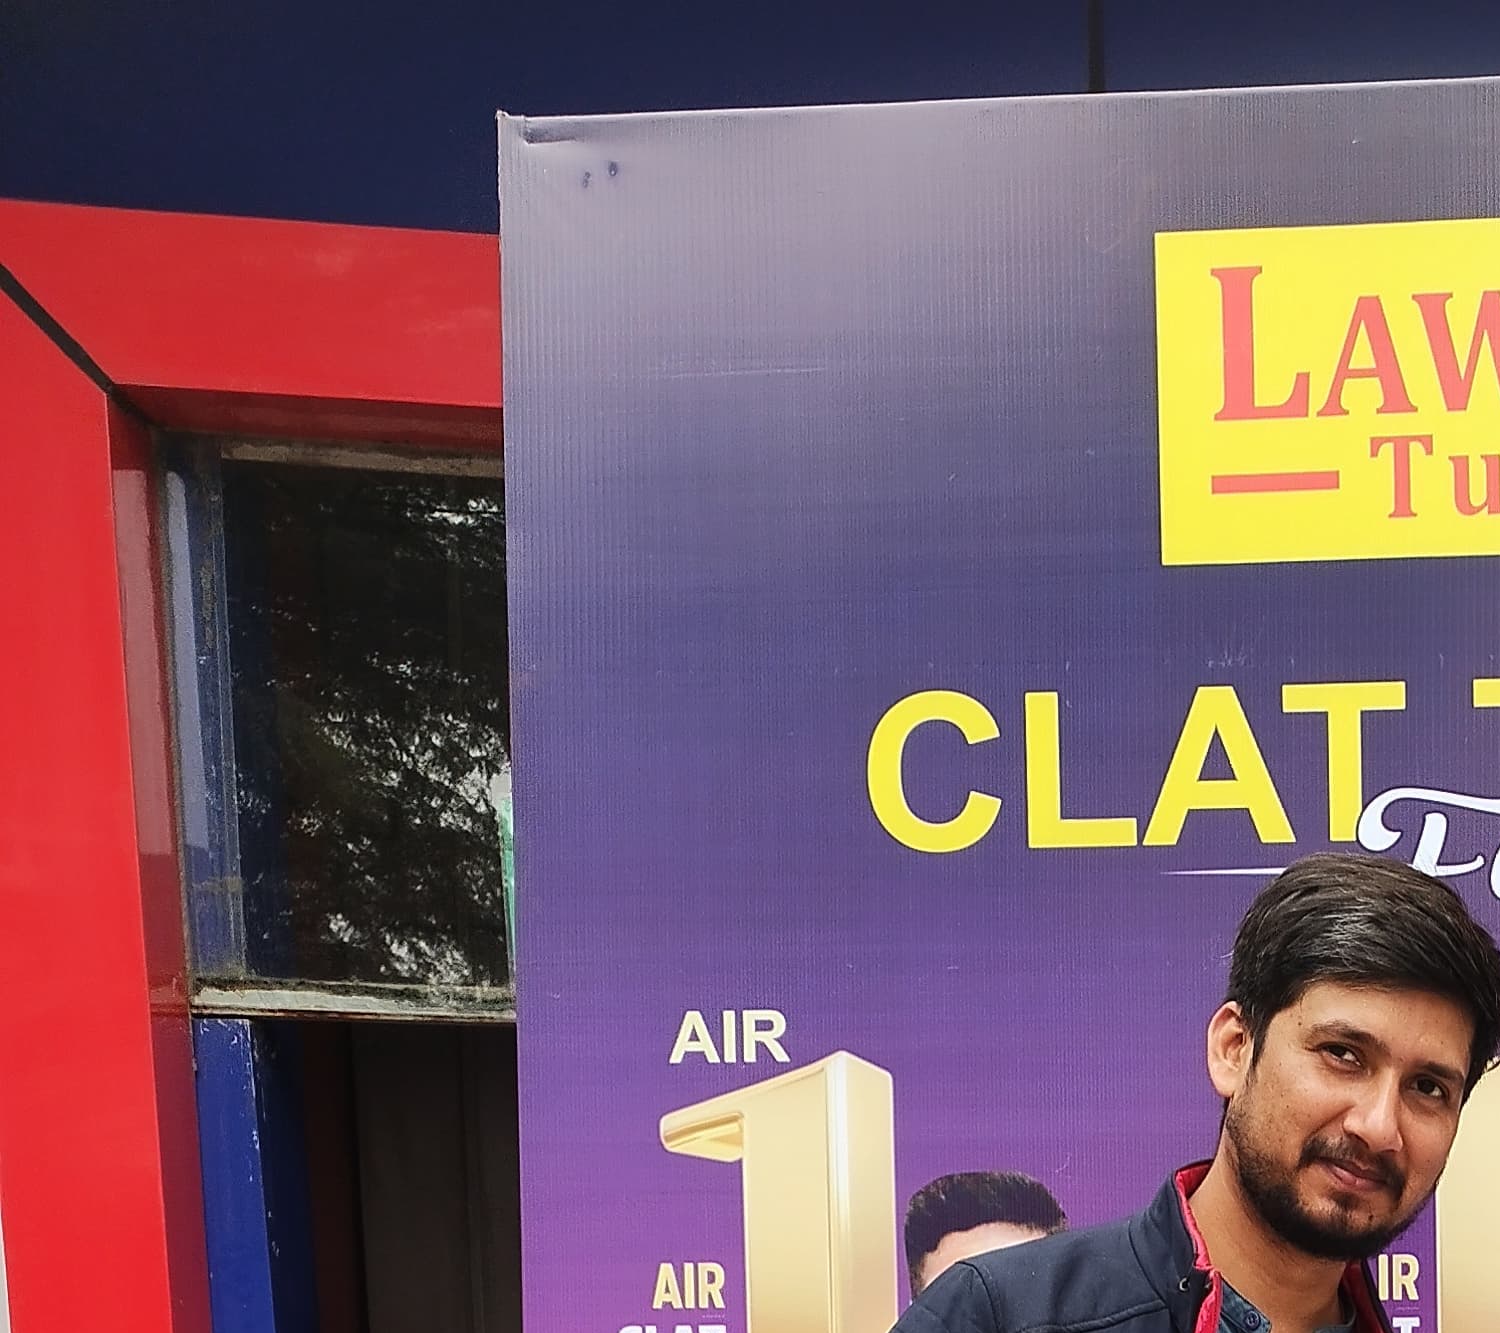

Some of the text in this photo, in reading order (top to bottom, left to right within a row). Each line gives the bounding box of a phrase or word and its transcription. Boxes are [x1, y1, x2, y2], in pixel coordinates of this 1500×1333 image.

[866, 680, 1407, 853] CLAT
[668, 1009, 791, 1065] AIR
[652, 1262, 727, 1310] AIR
[1378, 1253, 1420, 1301] IR
